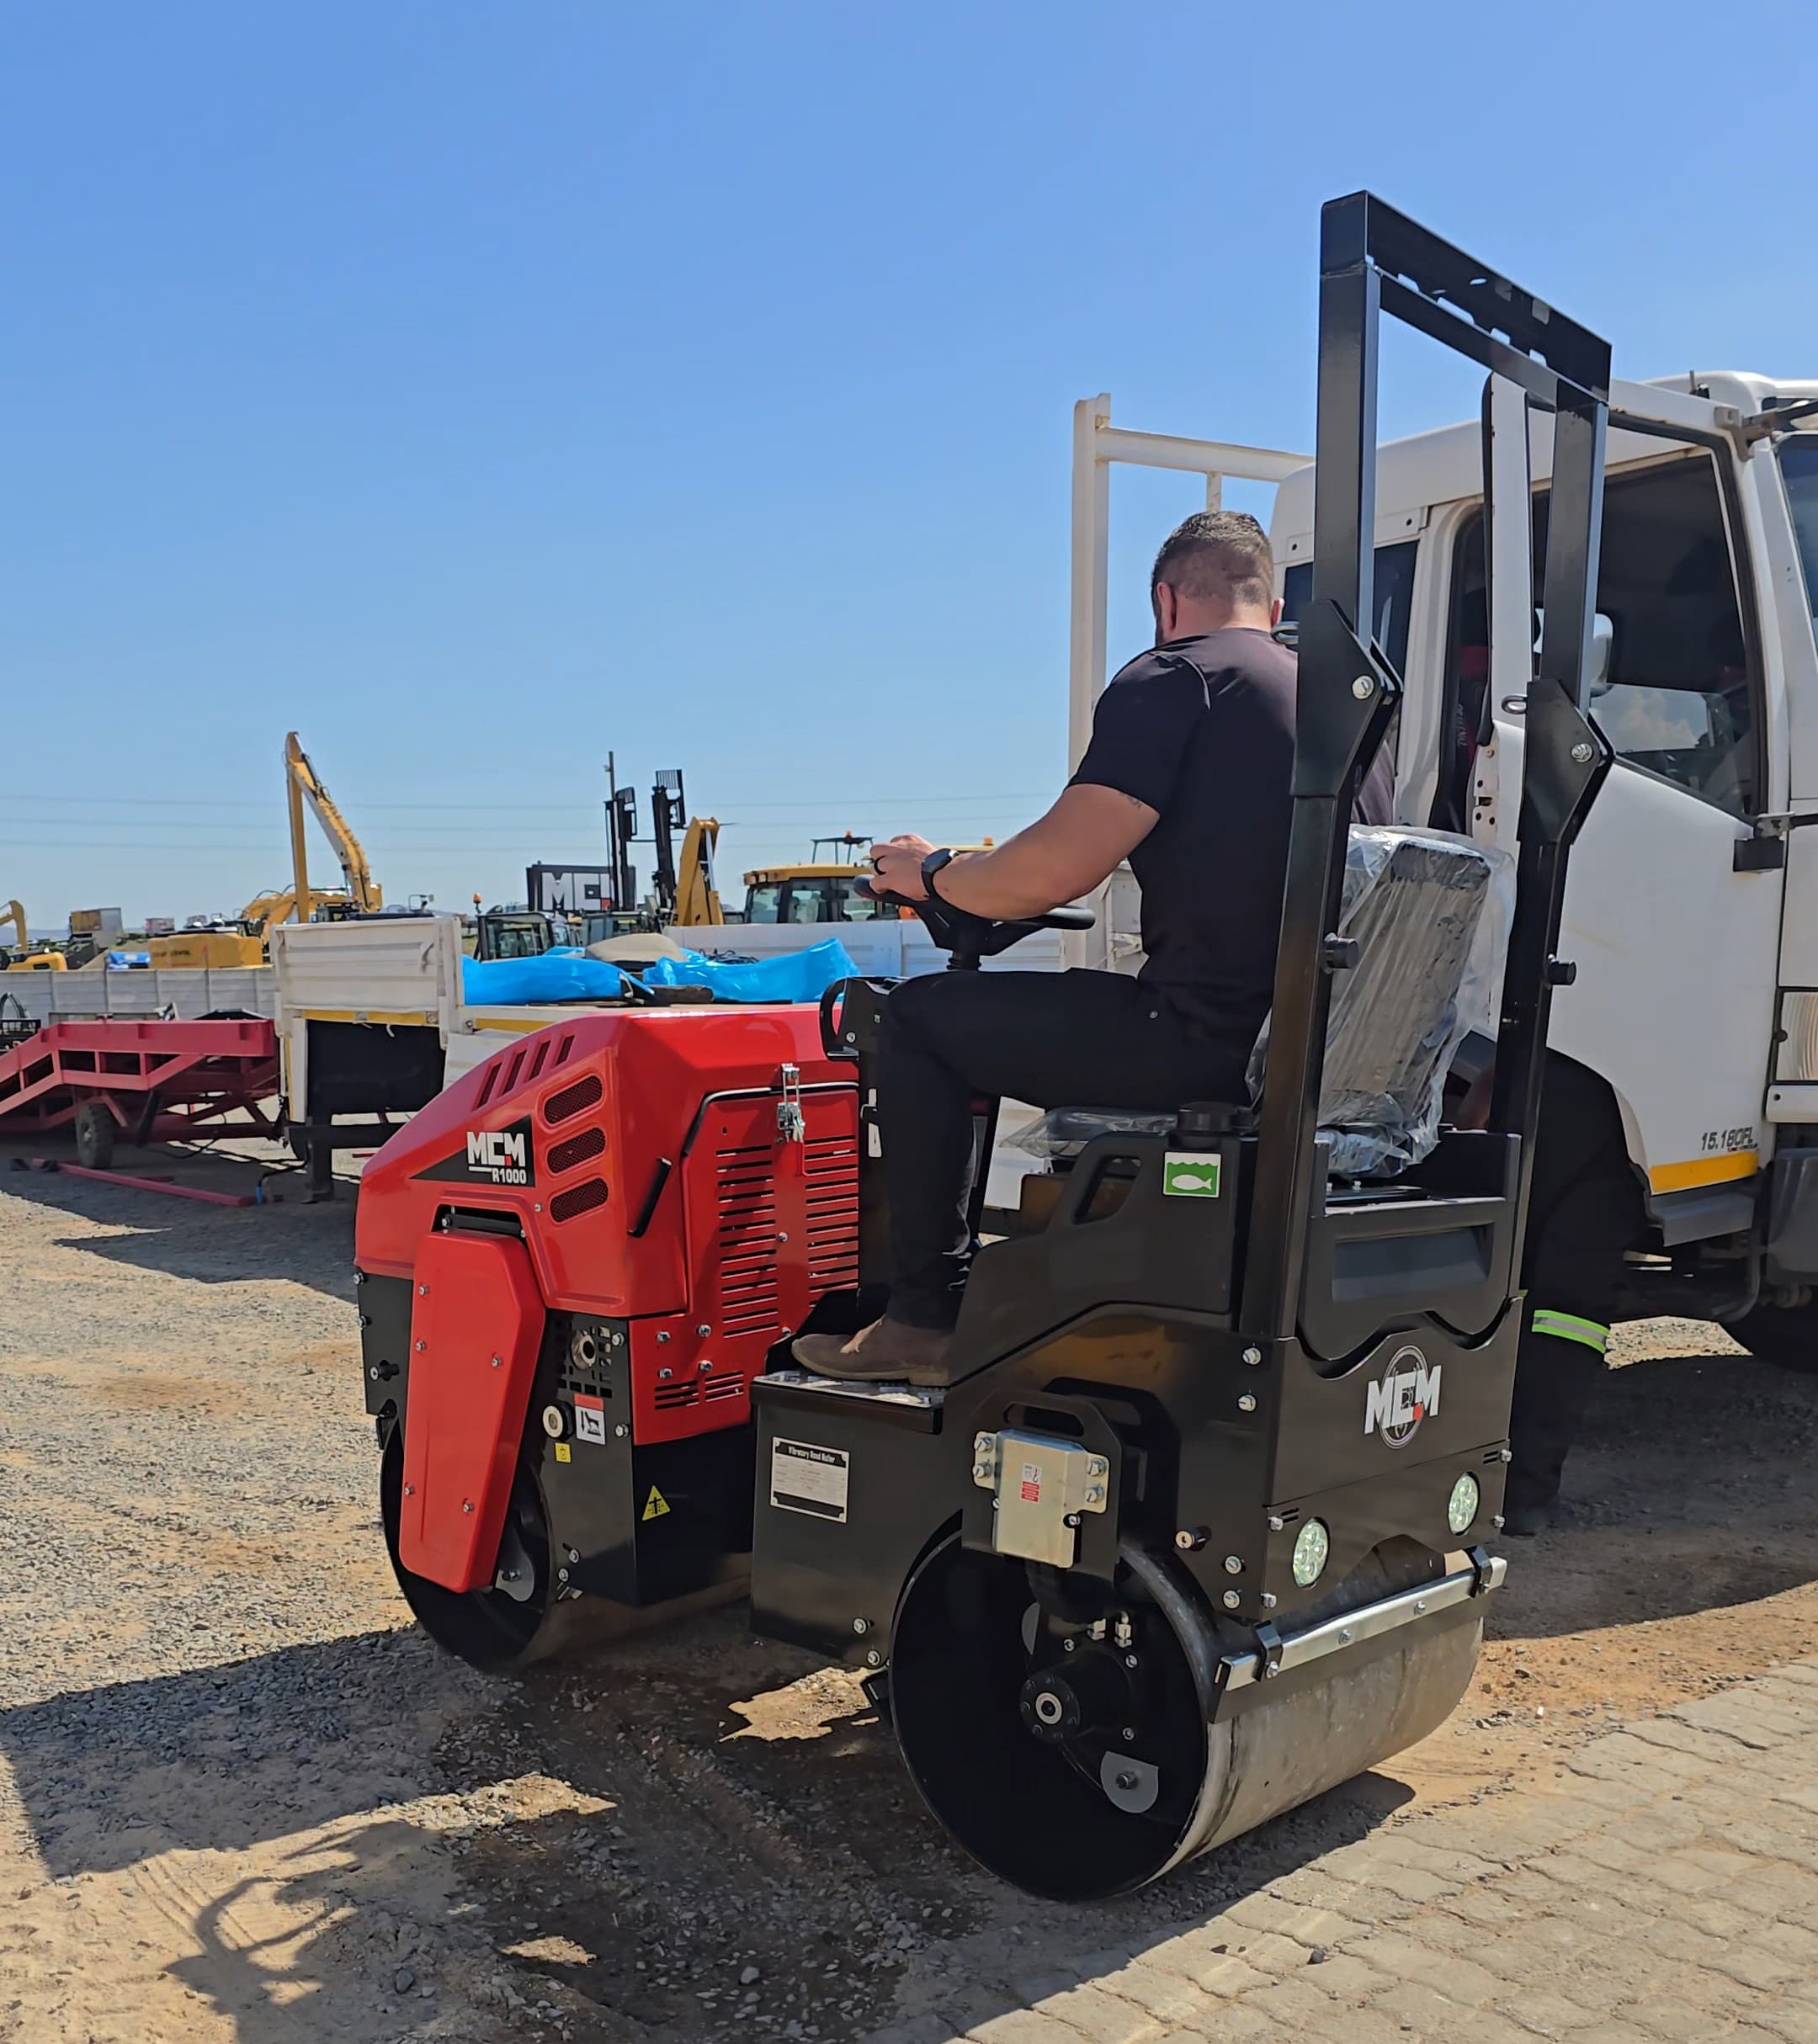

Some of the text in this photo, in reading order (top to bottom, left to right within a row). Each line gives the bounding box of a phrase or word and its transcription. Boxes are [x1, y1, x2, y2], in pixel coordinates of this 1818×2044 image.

[466, 1131, 526, 1167] MCM
[492, 1167, 527, 1184] R1000
[1364, 1365, 1442, 1435] MCM
